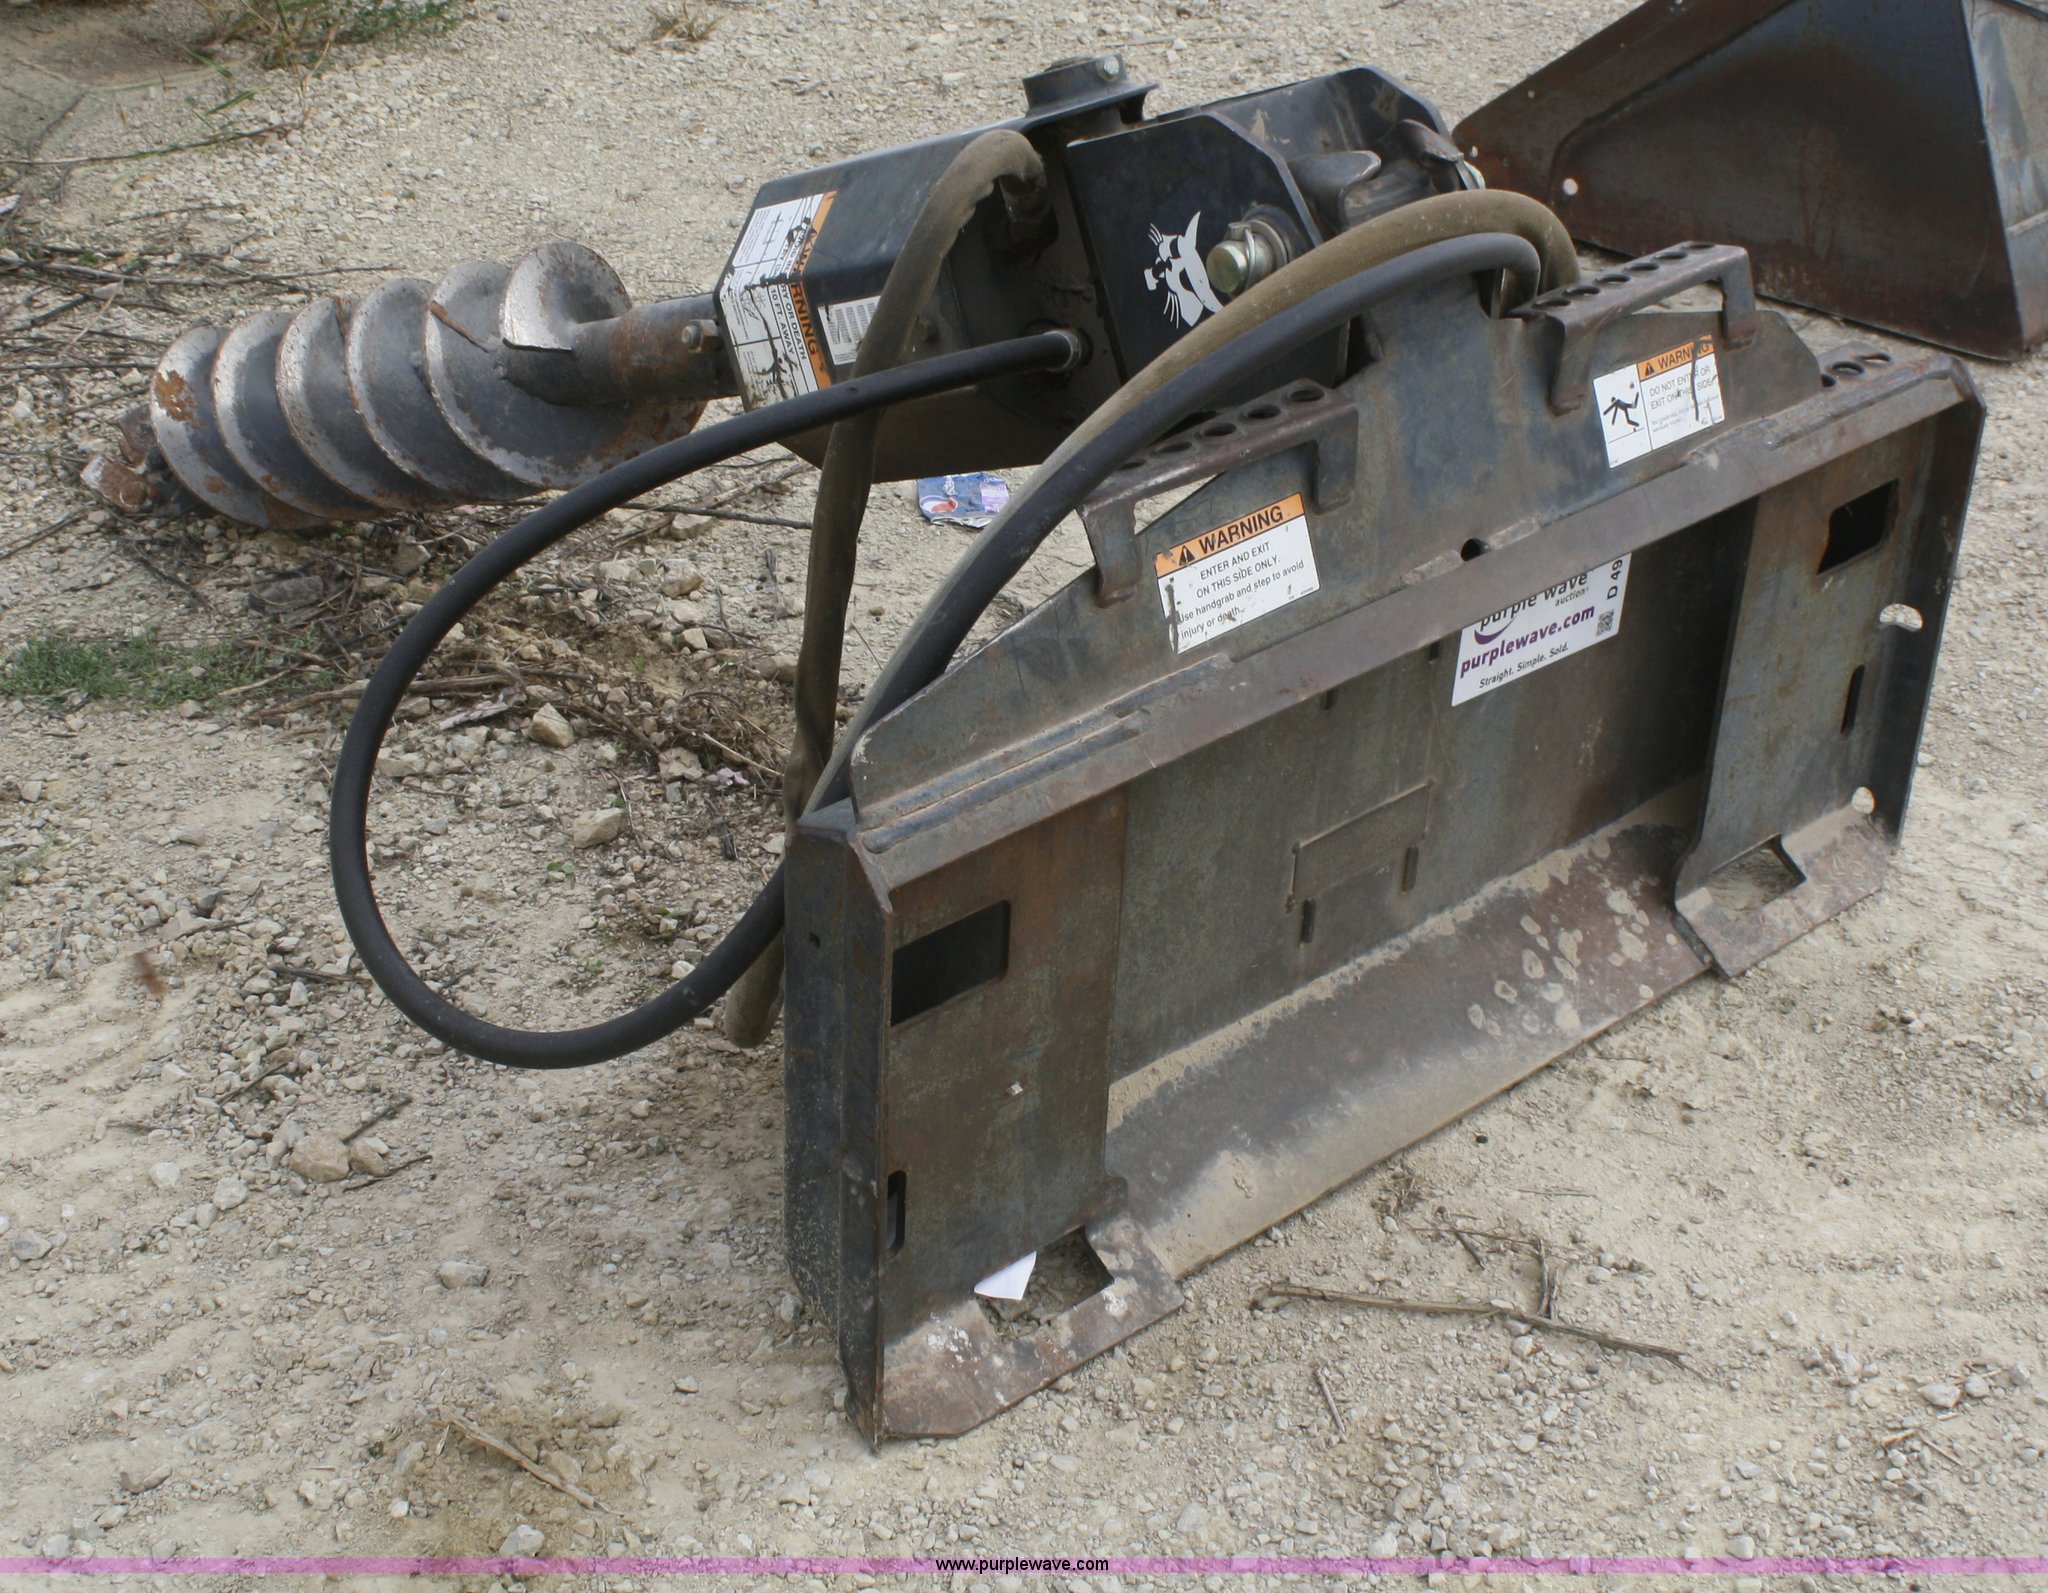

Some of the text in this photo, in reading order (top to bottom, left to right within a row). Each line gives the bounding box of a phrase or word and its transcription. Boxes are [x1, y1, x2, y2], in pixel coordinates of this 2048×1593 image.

[780, 323, 795, 354] AWAY
[785, 303, 794, 319] OR
[791, 323, 807, 360] DEATH
[1649, 386, 1660, 397] DO
[1661, 379, 1677, 391] NOT
[1700, 365, 1711, 376] OR
[1650, 397, 1665, 410] EXIT
[1199, 506, 1283, 554] WARNING
[1196, 555, 1280, 599] ON THIS SIDE ONLY.
[1200, 541, 1271, 580] ENTER AND EXIT
[1196, 592, 1235, 616] handgrab
[1236, 584, 1252, 598] and
[1253, 575, 1271, 592] step
[1273, 571, 1281, 581] to
[1282, 560, 1304, 577] avoid
[1206, 617, 1215, 628] or
[1460, 605, 1595, 678] purplewave.com
[1479, 642, 1568, 688] Straight. Simple. Sold.
